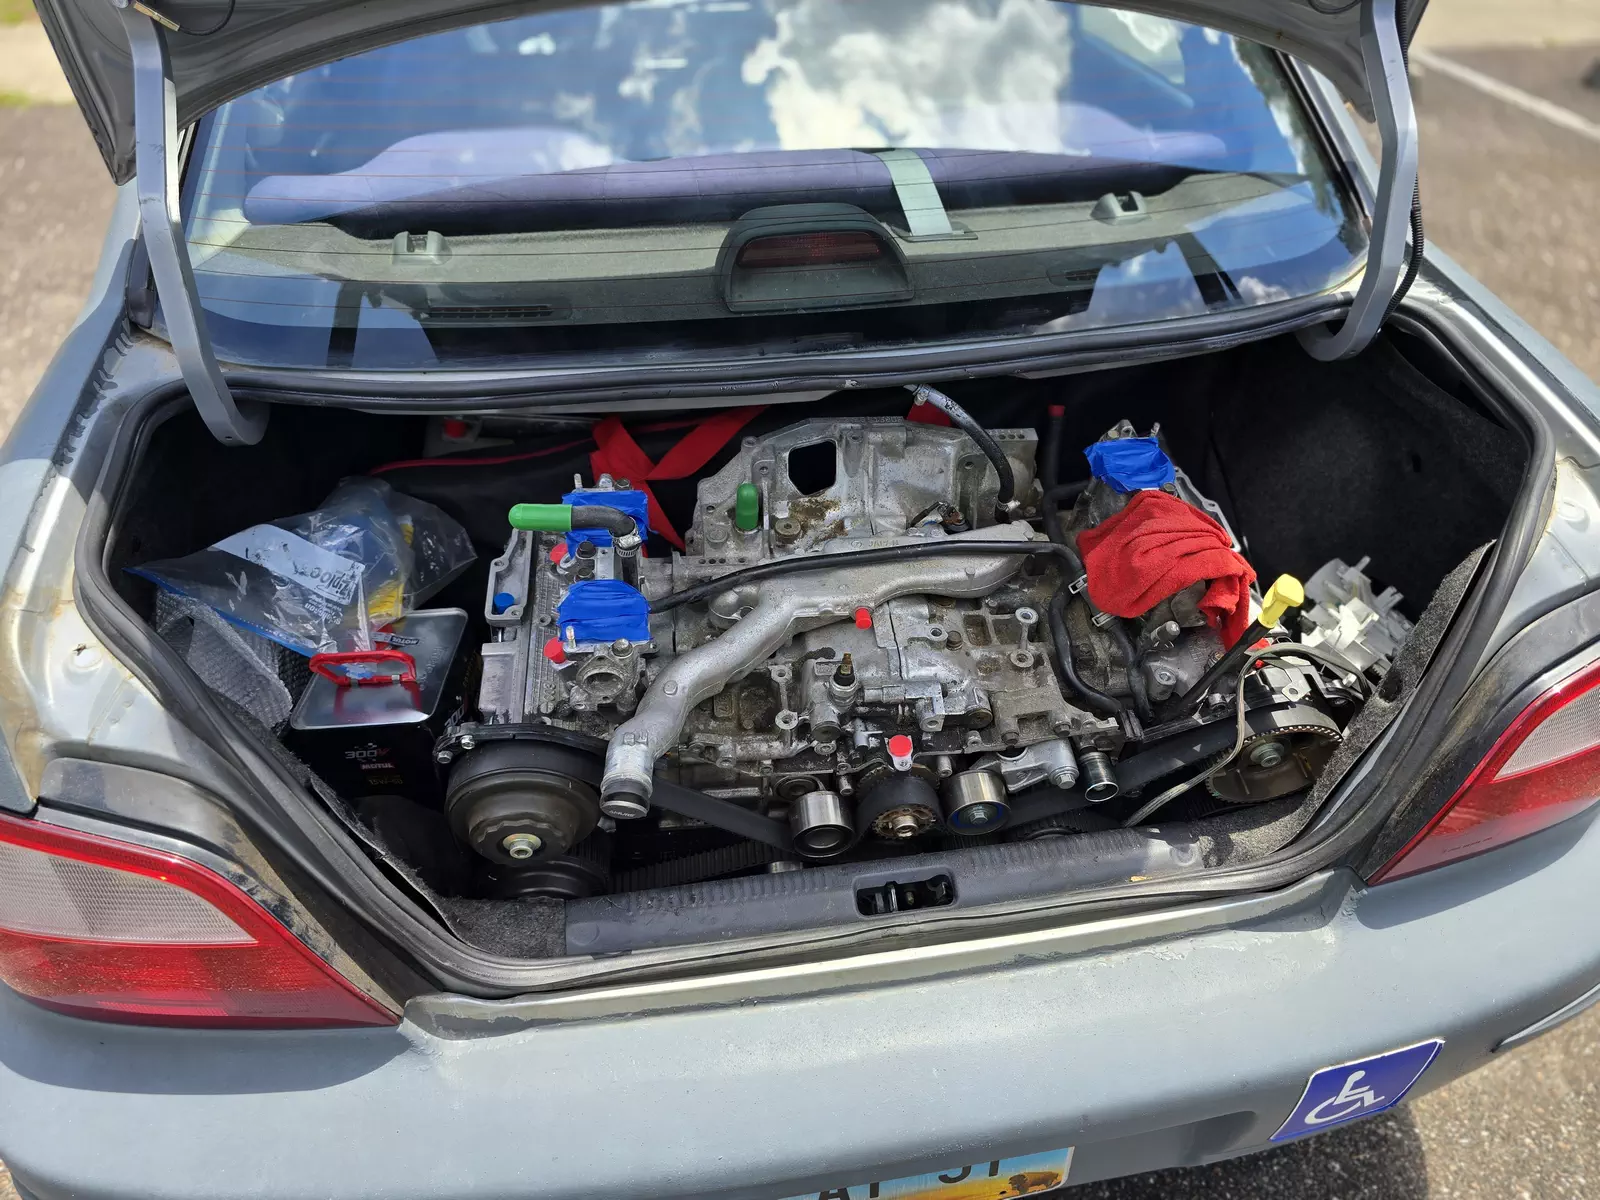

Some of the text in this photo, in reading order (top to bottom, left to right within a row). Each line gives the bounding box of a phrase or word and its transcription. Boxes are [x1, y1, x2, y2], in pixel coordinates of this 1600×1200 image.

[392, 636, 418, 645] MOTUL
[344, 747, 392, 760] 300V
[360, 762, 396, 770] MOTUL
